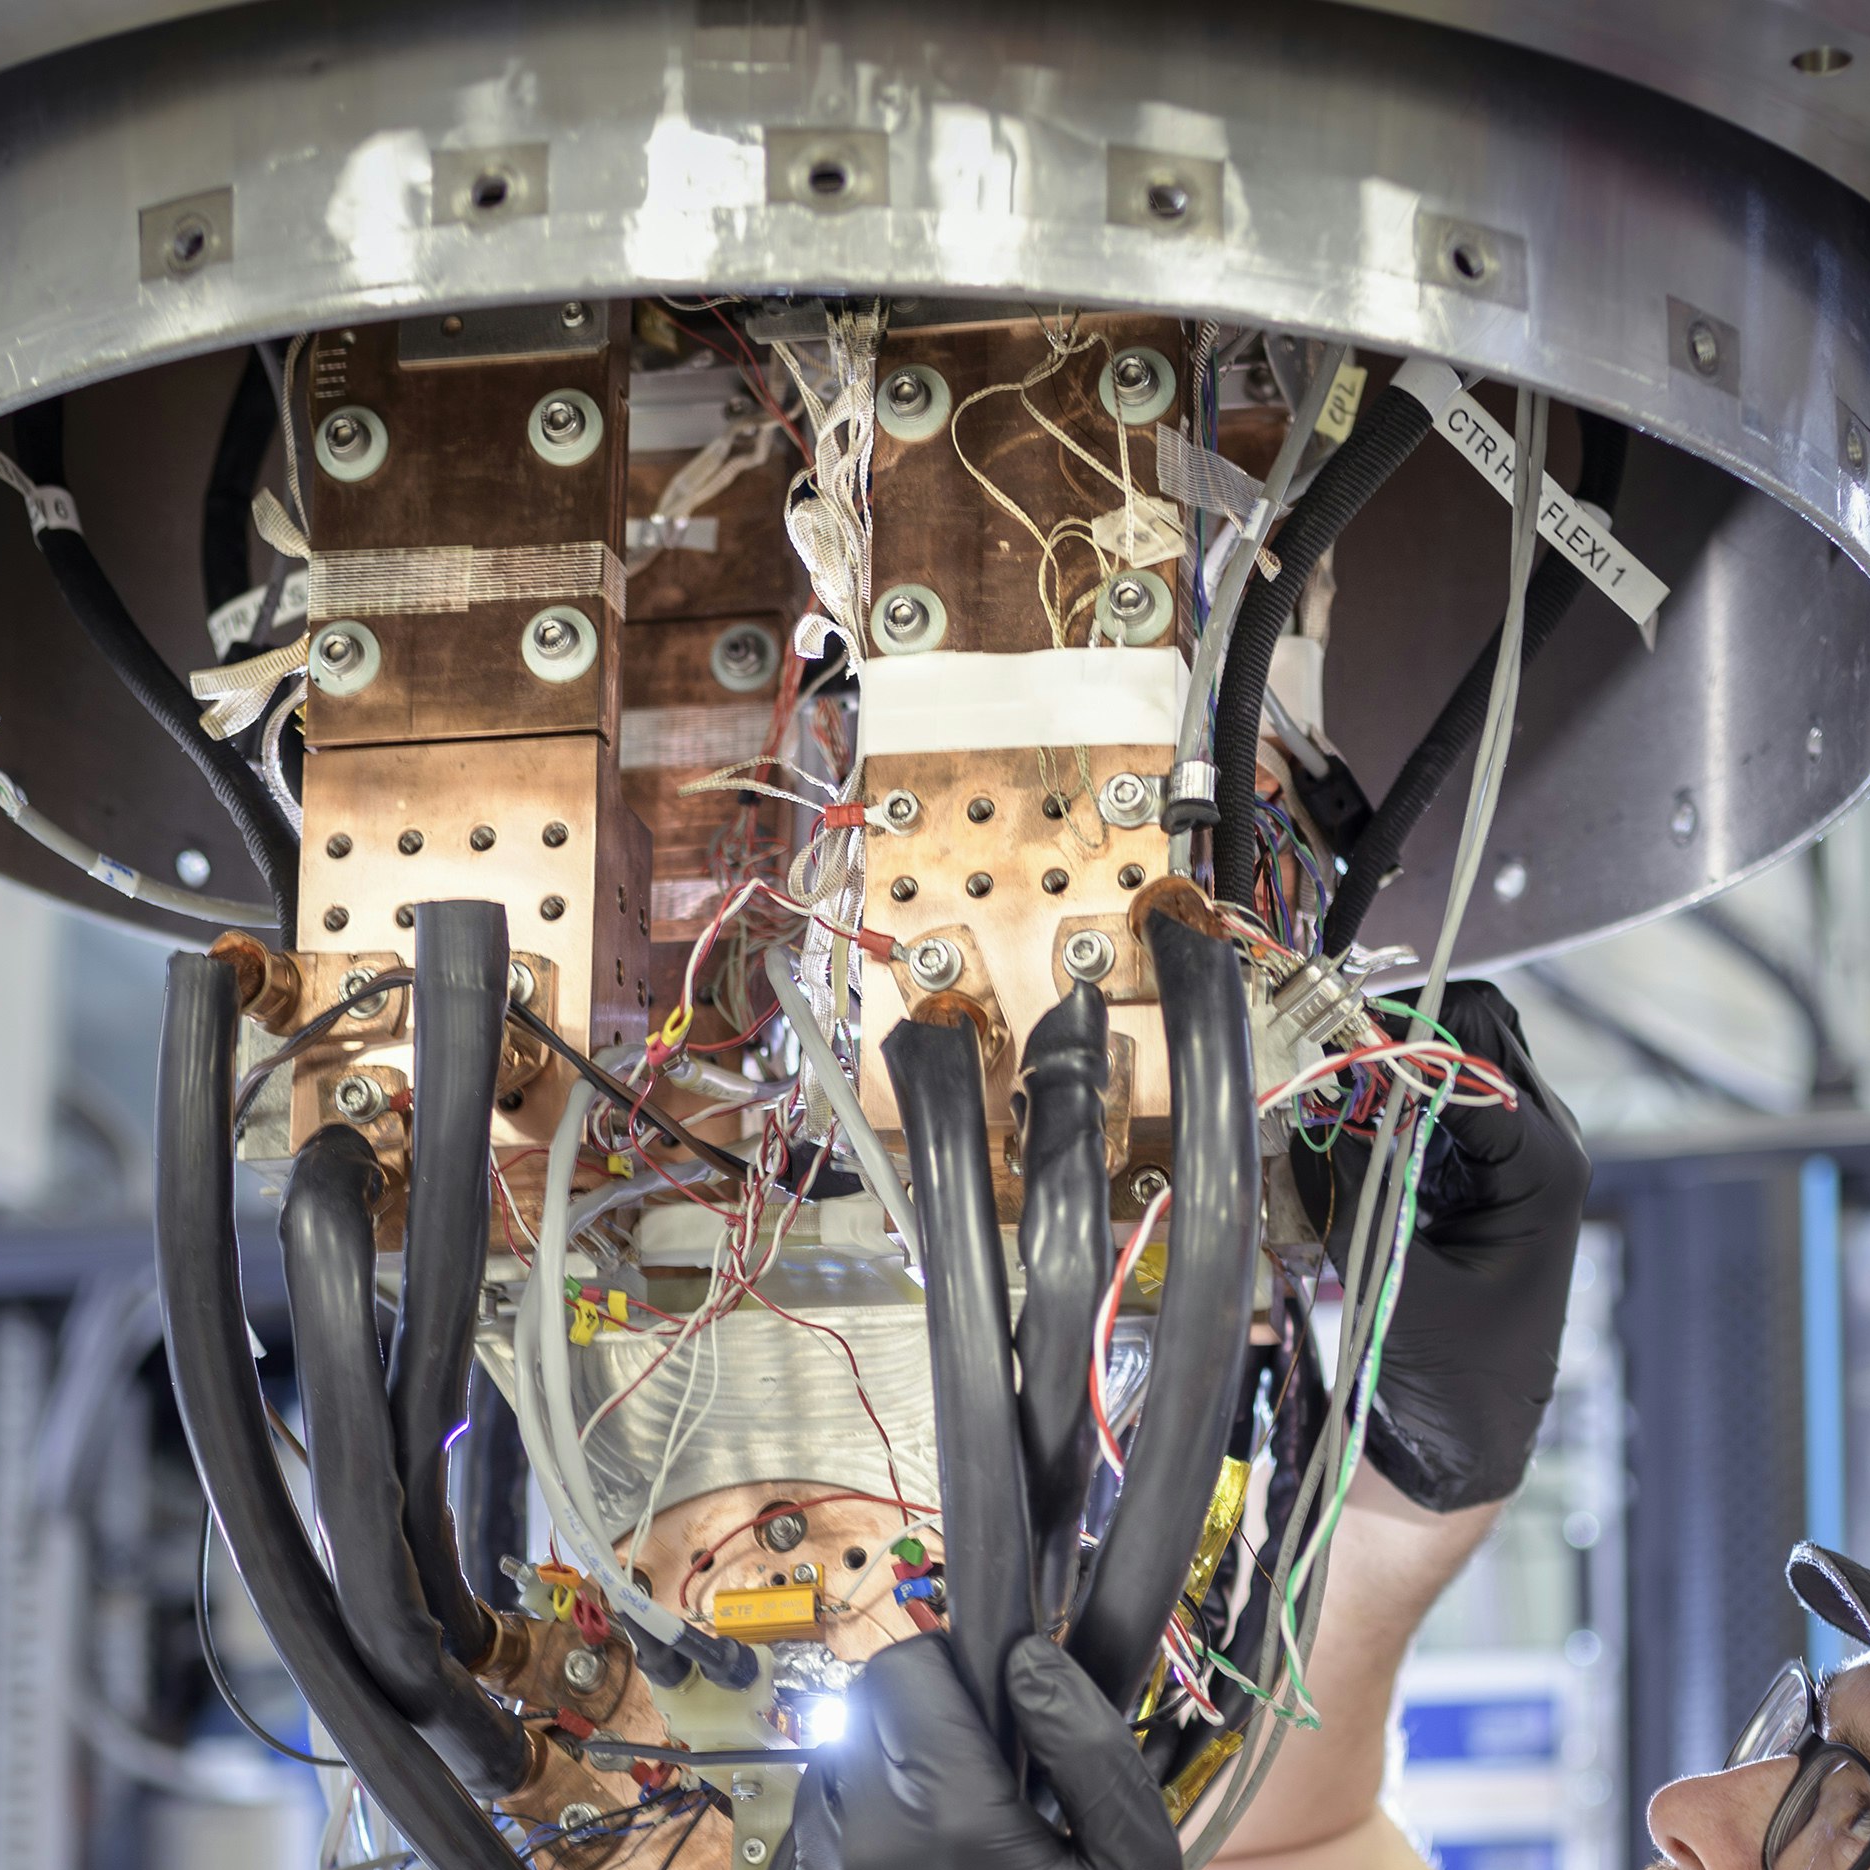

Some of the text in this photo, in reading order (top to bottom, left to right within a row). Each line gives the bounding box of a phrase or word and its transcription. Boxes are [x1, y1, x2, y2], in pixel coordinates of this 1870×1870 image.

[1447, 408, 1497, 465] CTR
[1540, 501, 1611, 573] FLEXI
[1612, 567, 1627, 588] 1
